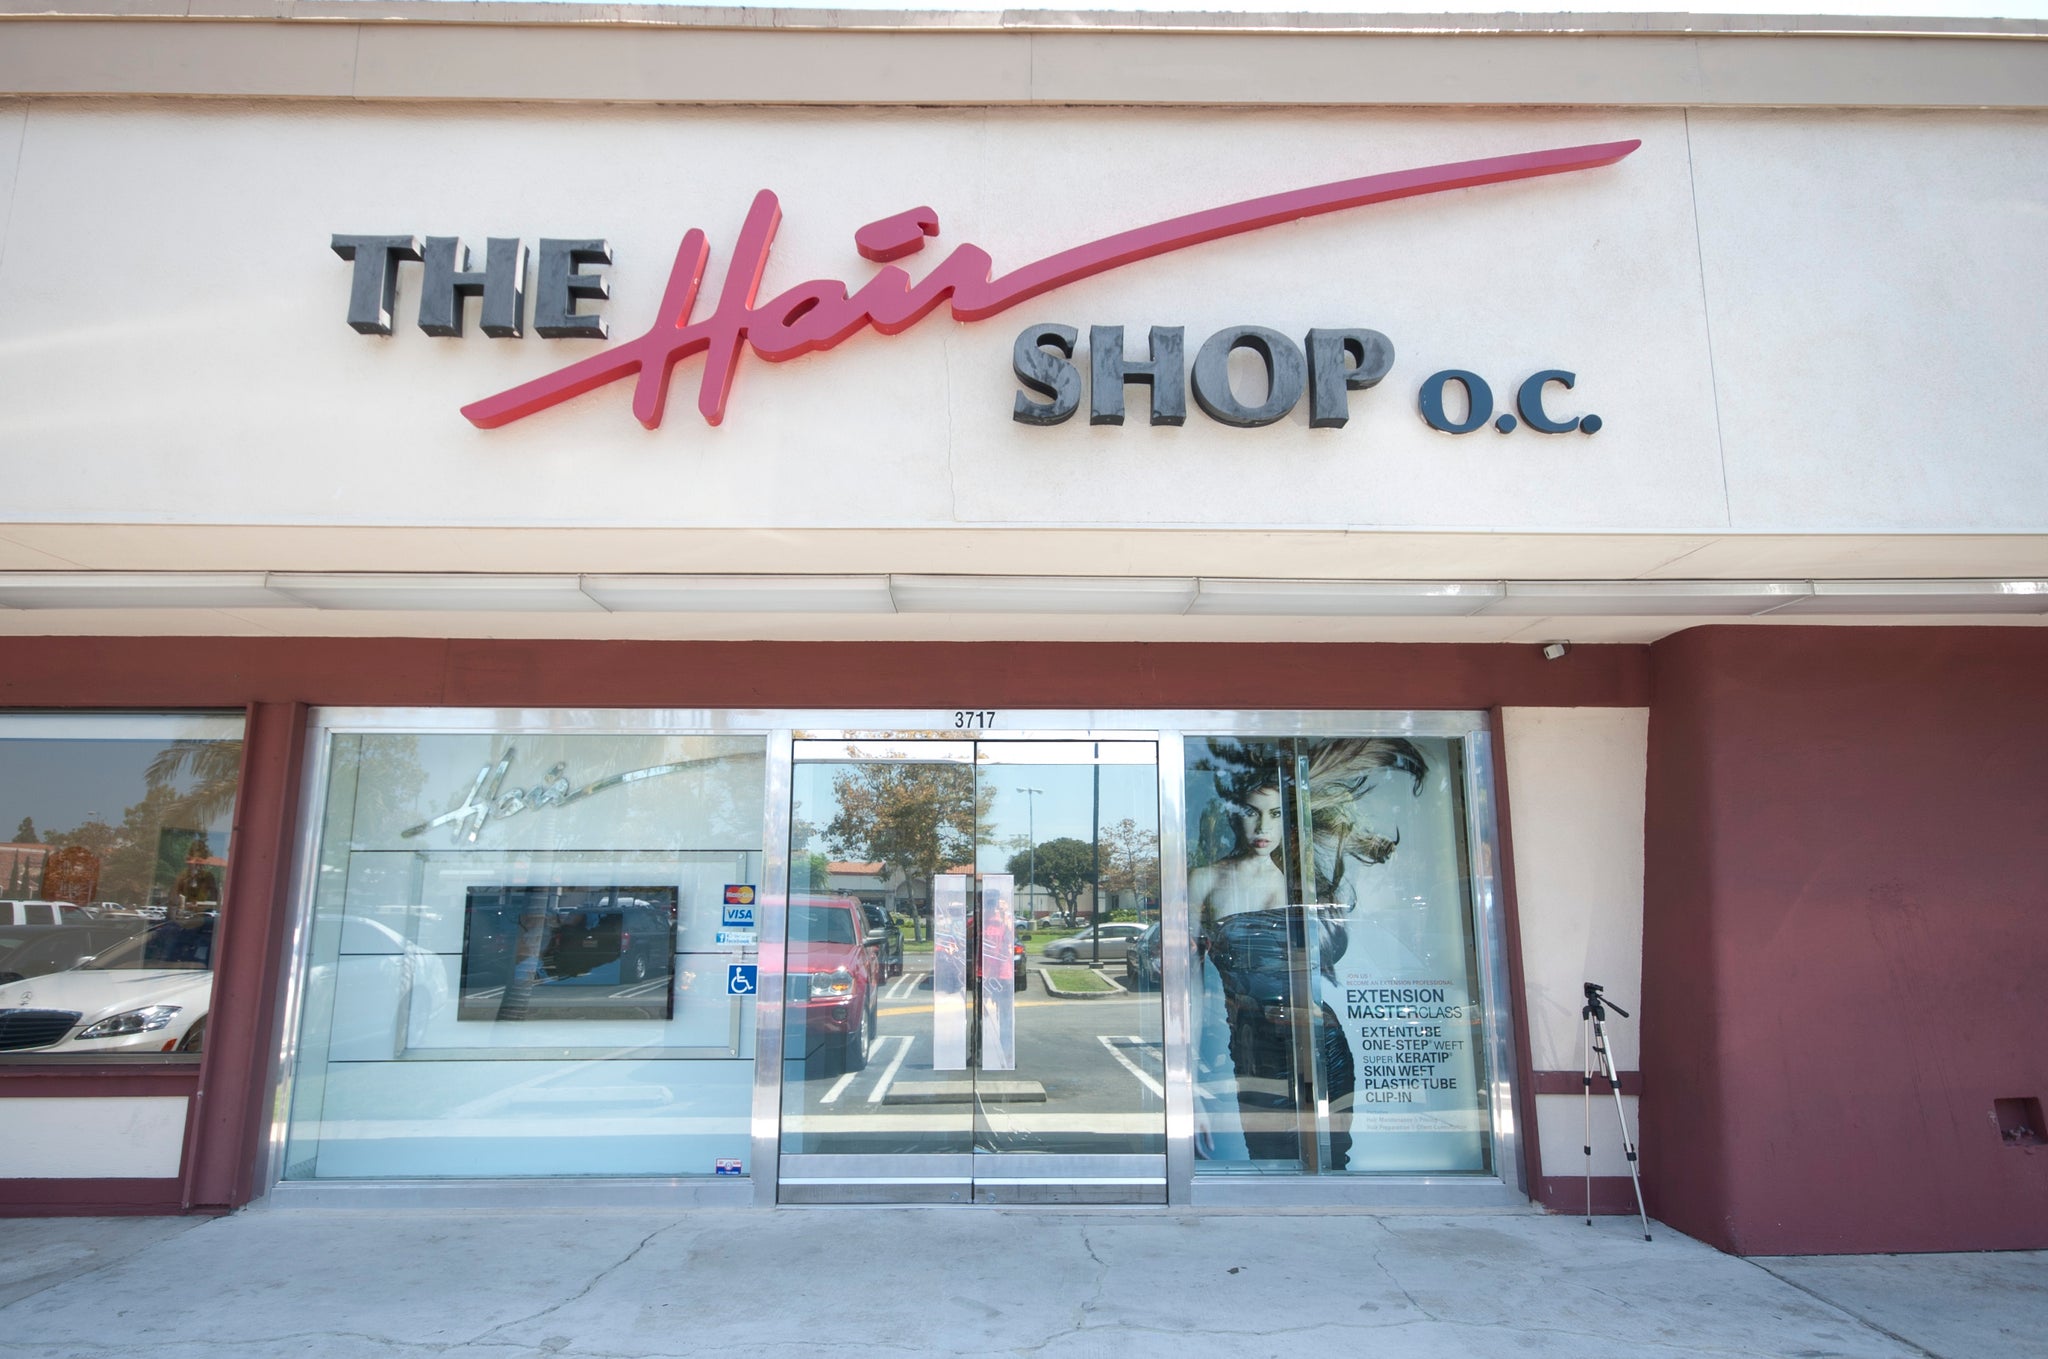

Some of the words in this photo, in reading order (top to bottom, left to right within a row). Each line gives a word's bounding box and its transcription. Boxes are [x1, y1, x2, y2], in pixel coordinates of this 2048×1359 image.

[331, 233, 614, 340] THE
[1013, 322, 1396, 430] SHOP
[954, 711, 996, 729] 3717
[727, 909, 753, 920] VISA
[1346, 988, 1445, 1003] EXTENSION
[1347, 1005, 1463, 1019] MASTERCLASS
[1361, 1026, 1442, 1038] EXTENTUBE
[1433, 1041, 1464, 1050] WEFT
[1362, 1055, 1394, 1064] SUPER
[1364, 1065, 1396, 1077] SKIN
[1398, 1065, 1436, 1077] WEFT
[1364, 1078, 1420, 1090] PLASTIC
[1422, 1078, 1457, 1090] TUBE
[1365, 1091, 1412, 1103] CLIP-IN
